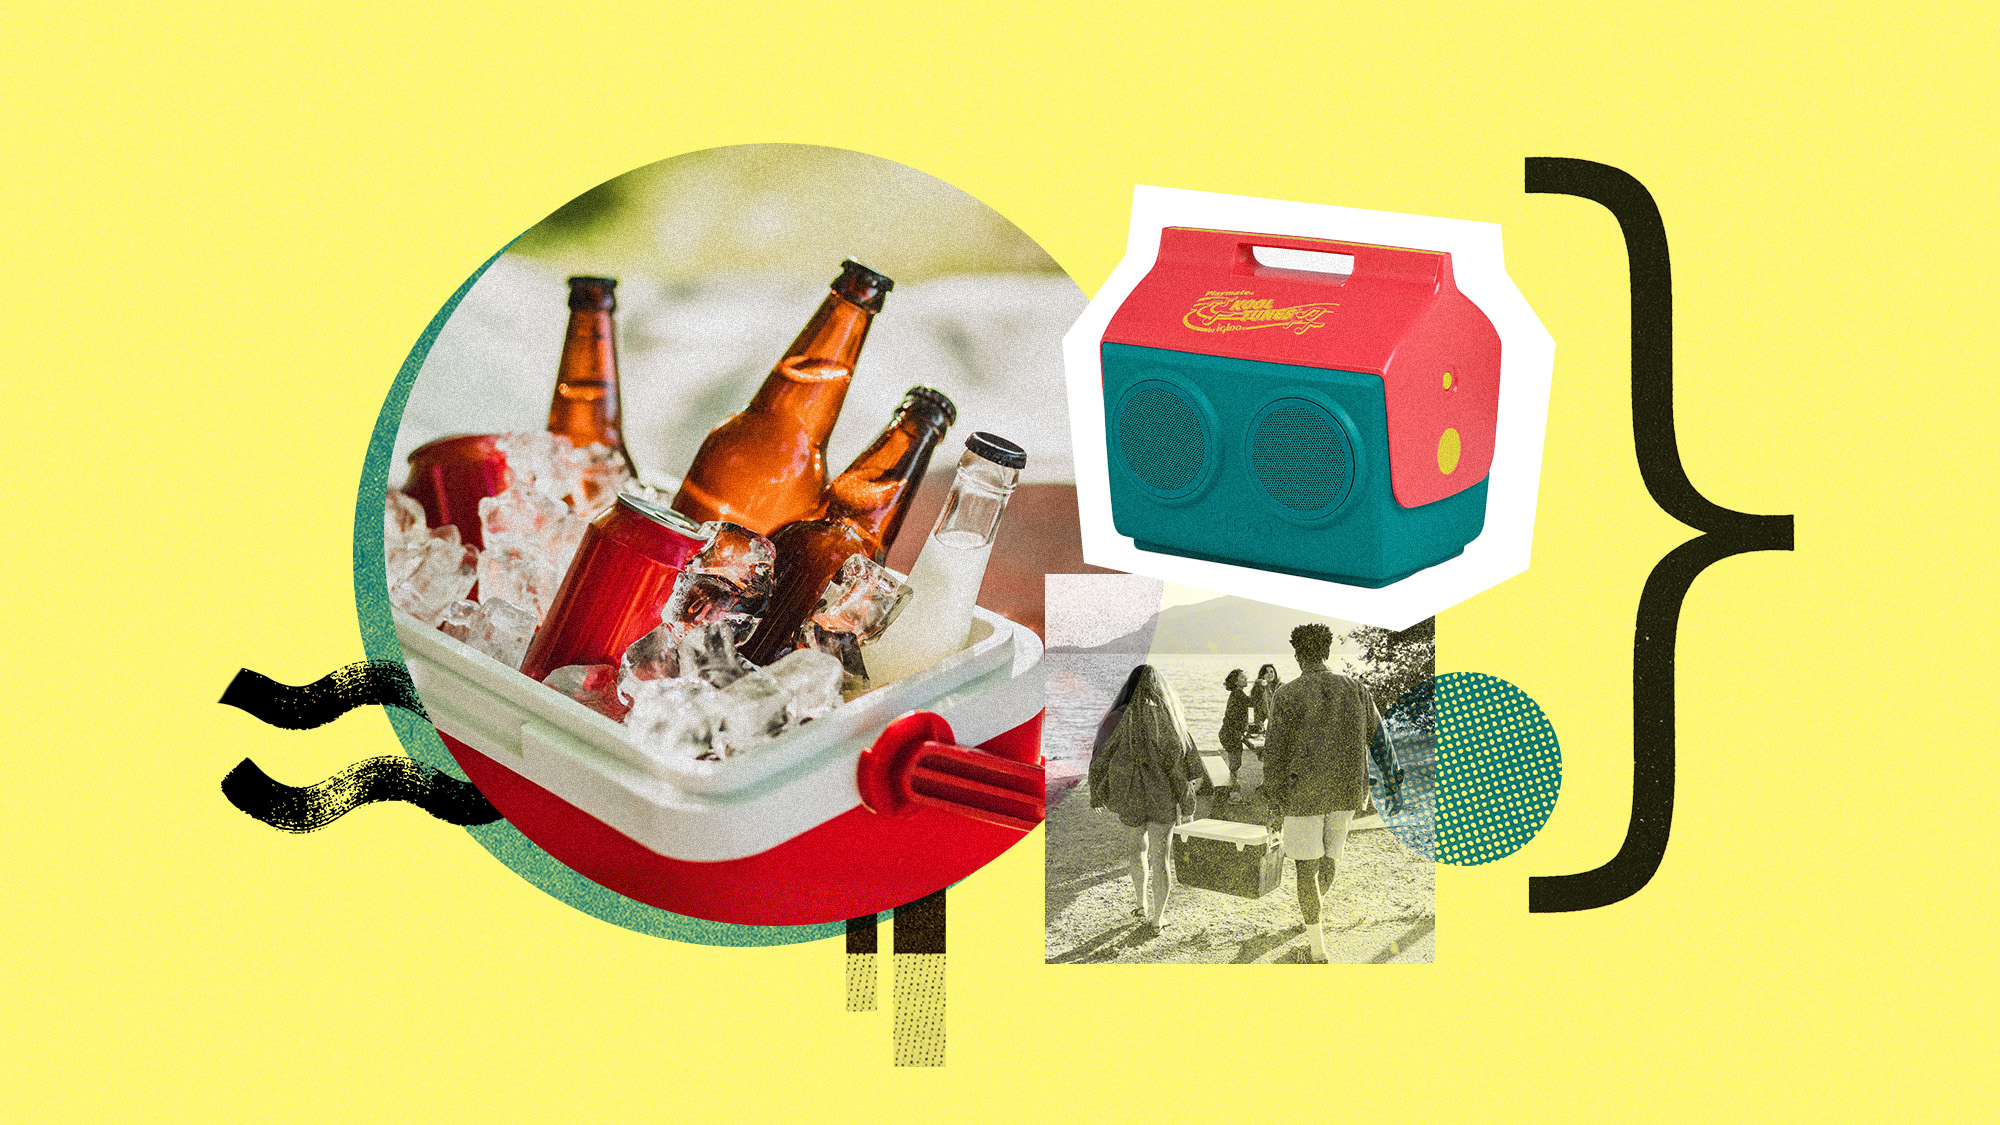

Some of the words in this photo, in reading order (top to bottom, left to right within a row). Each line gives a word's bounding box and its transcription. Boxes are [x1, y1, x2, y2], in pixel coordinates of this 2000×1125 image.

[1229, 299, 1275, 311] KOOL
[1240, 309, 1296, 322] TUNES
[1216, 323, 1242, 334] igloo
